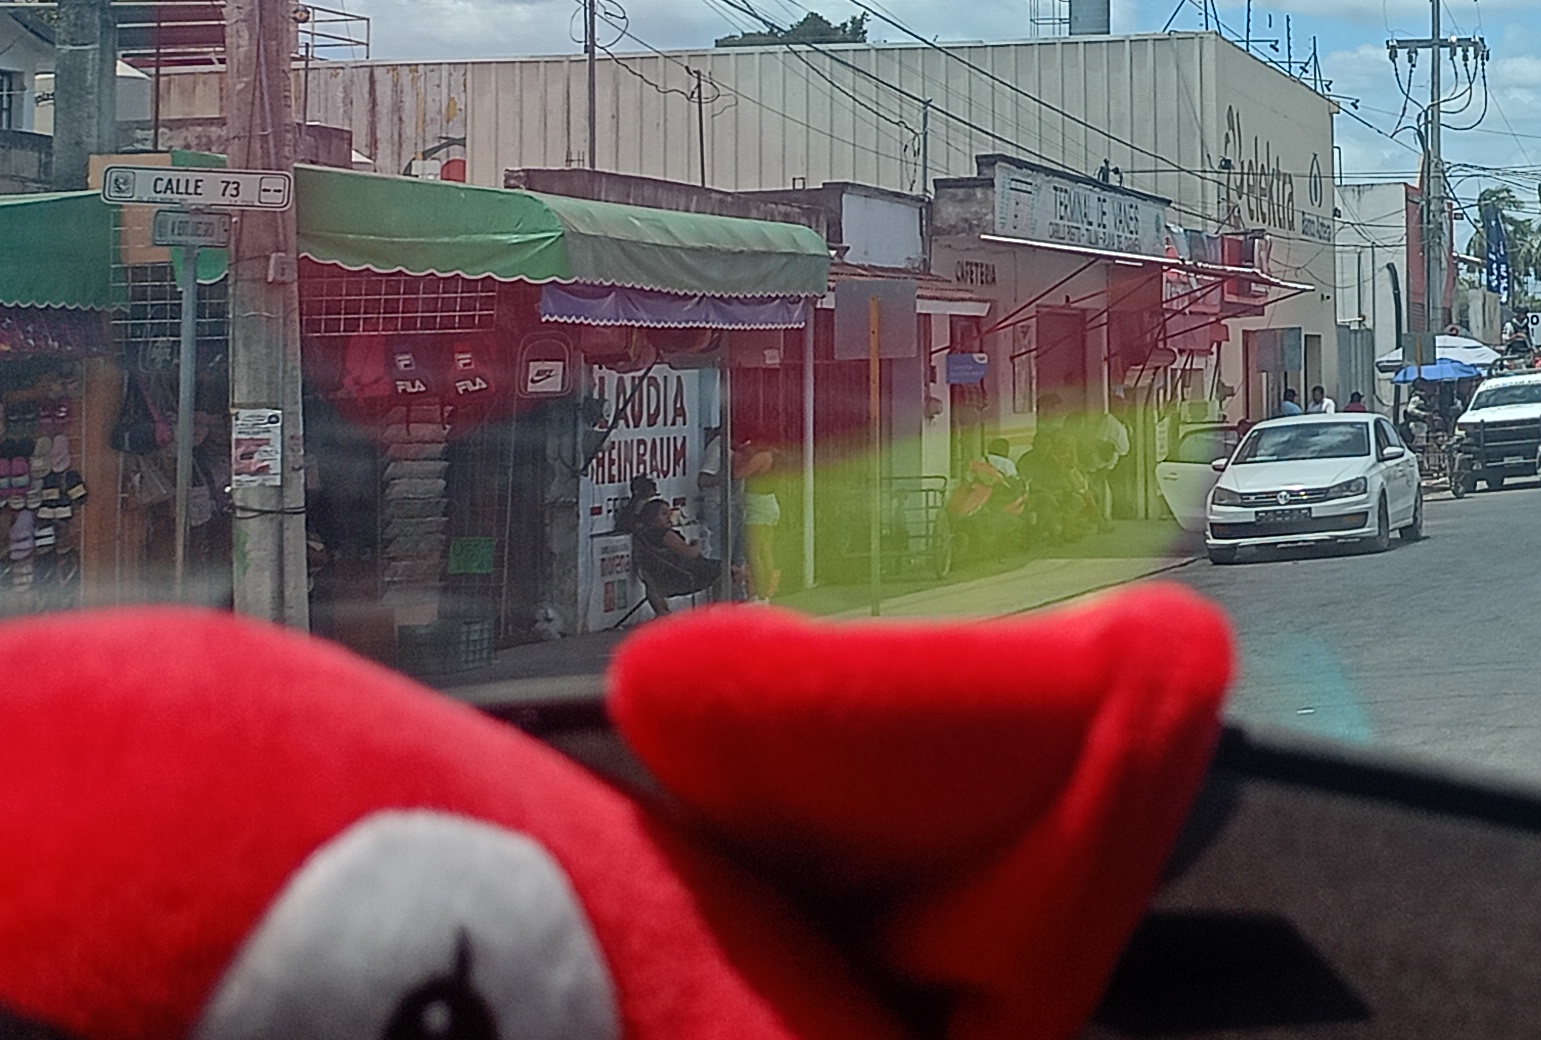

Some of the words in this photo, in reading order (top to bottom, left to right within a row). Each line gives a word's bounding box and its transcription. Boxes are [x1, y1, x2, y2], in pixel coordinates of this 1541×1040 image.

[153, 178, 204, 196] CALLE
[220, 181, 241, 198] 73
[396, 380, 427, 394] FILA
[455, 377, 488, 395] FILA
[591, 375, 688, 429] LAUDIA
[590, 436, 688, 484] HEINBAUM
